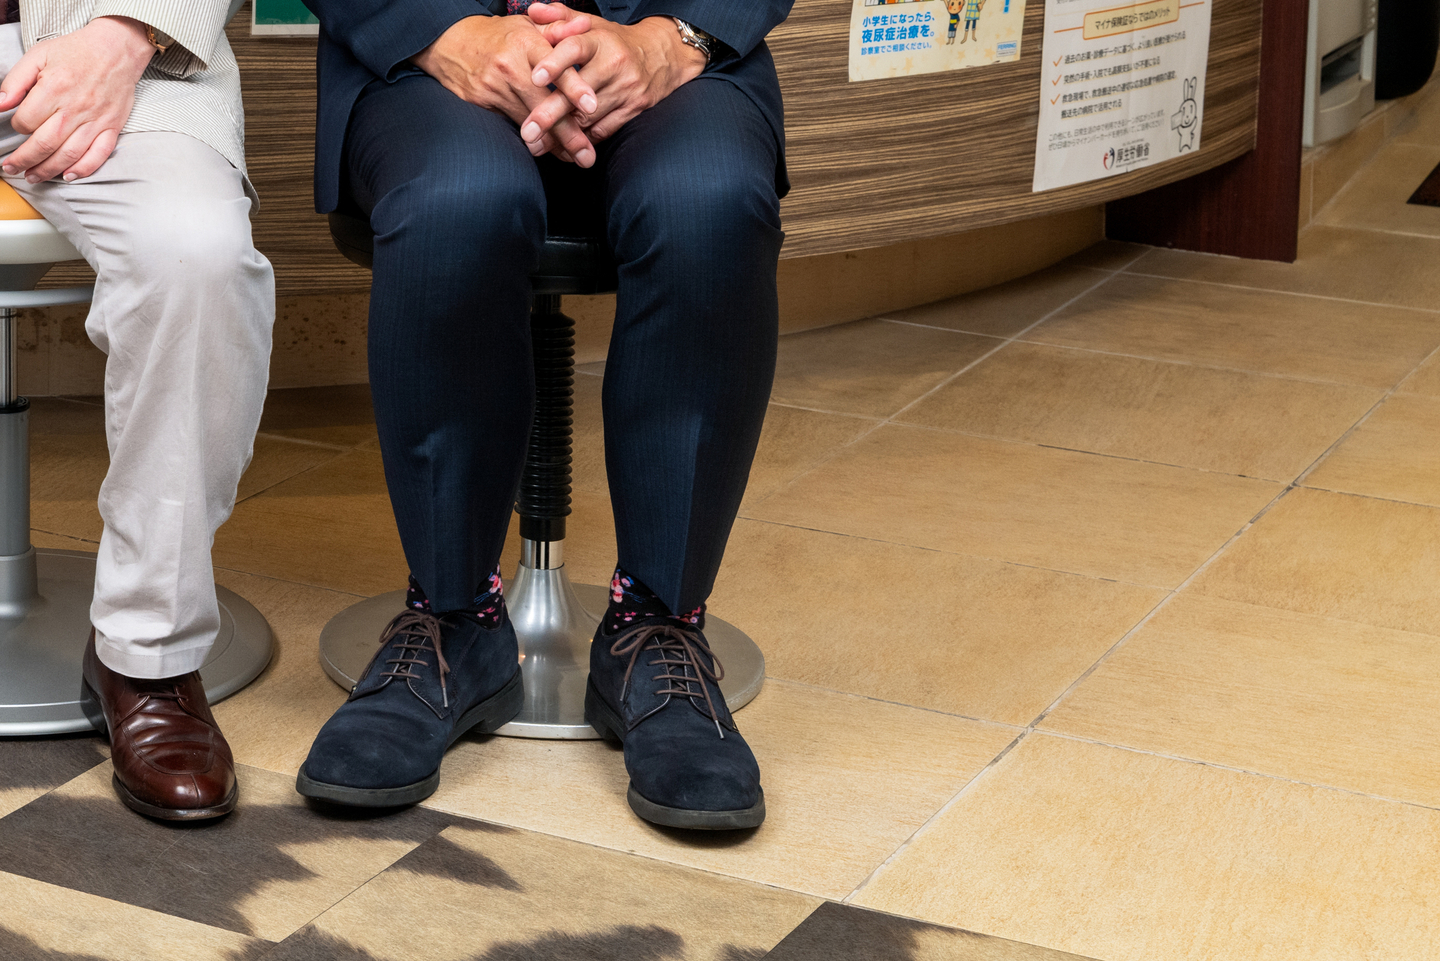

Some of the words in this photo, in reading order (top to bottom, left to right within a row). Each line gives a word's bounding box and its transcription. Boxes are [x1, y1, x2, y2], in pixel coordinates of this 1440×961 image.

[863, 11, 935, 27] 小学生になったら、
[1095, 6, 1171, 30] マイナ保険証ならではのメリット
[862, 24, 935, 44] 夜尿症治療を。
[861, 42, 933, 56] 診察室でご相談ください。
[1116, 142, 1150, 163] 厚生労働省
